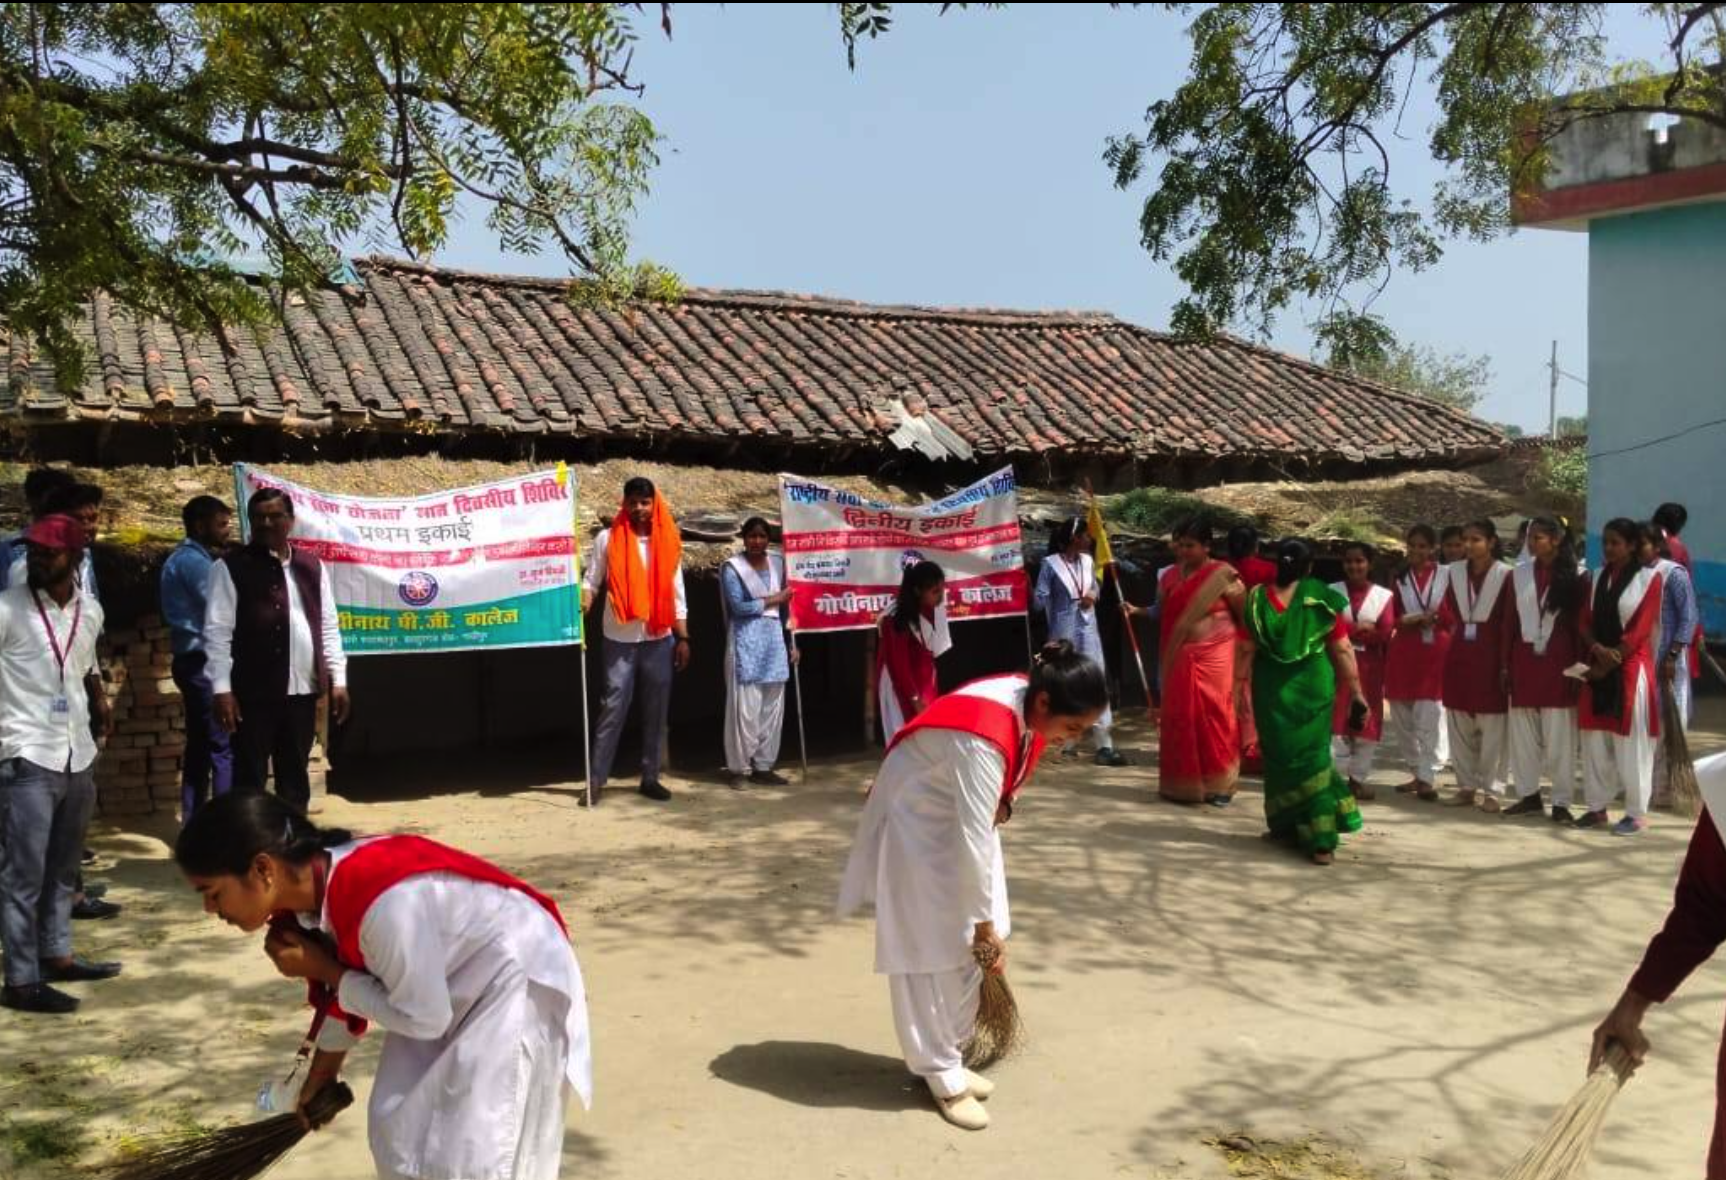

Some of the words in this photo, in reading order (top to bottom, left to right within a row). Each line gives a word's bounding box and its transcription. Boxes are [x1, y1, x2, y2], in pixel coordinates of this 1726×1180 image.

[454, 488, 516, 515] दिवसीय
[355, 523, 410, 545] प्रथम
[415, 516, 472, 544] इकाई
[918, 504, 978, 533] इकाई
[959, 581, 1012, 604] कालेज
[464, 607, 519, 627] कालेज
